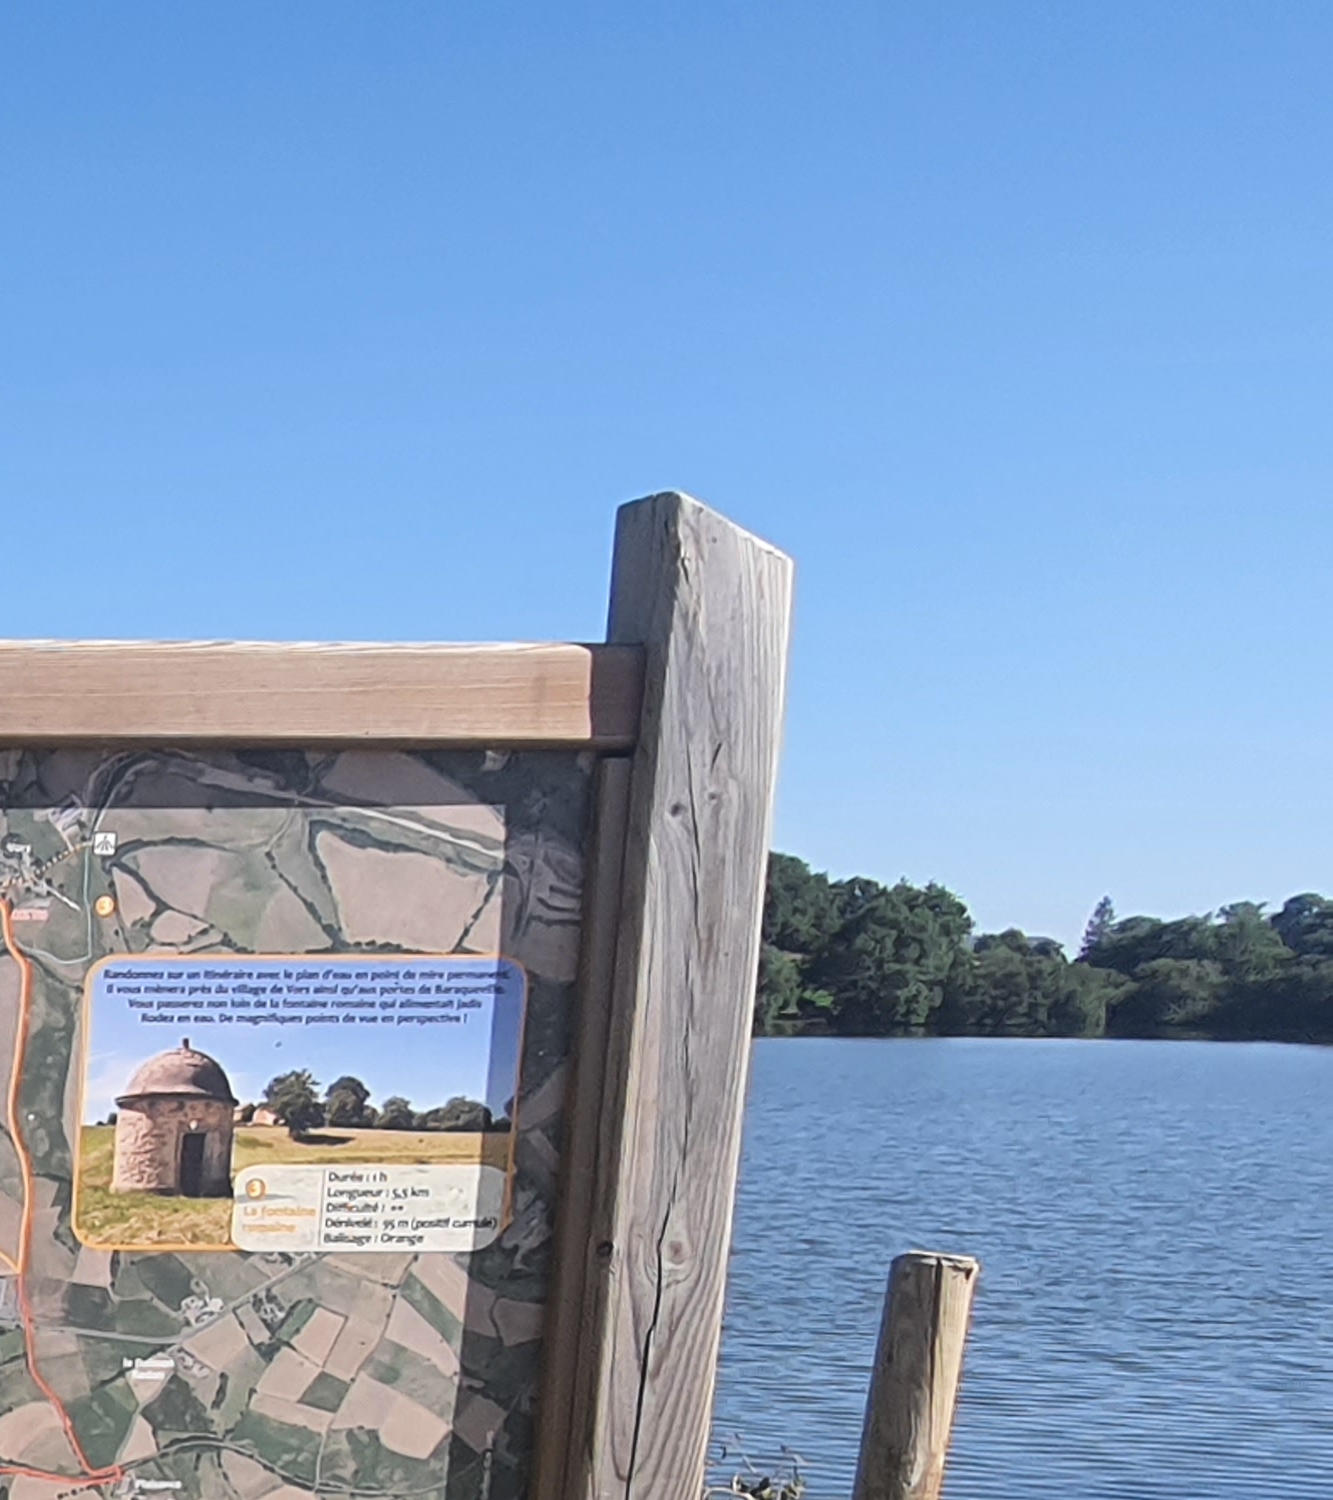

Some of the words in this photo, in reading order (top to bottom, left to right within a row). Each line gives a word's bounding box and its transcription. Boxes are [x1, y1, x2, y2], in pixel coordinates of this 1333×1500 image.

[329, 1172, 363, 1182] Durée
[327, 1188, 383, 1200] Longueur
[411, 1187, 429, 1197] km
[326, 1203, 379, 1213] Difficulté
[381, 1234, 424, 1246] Orange
